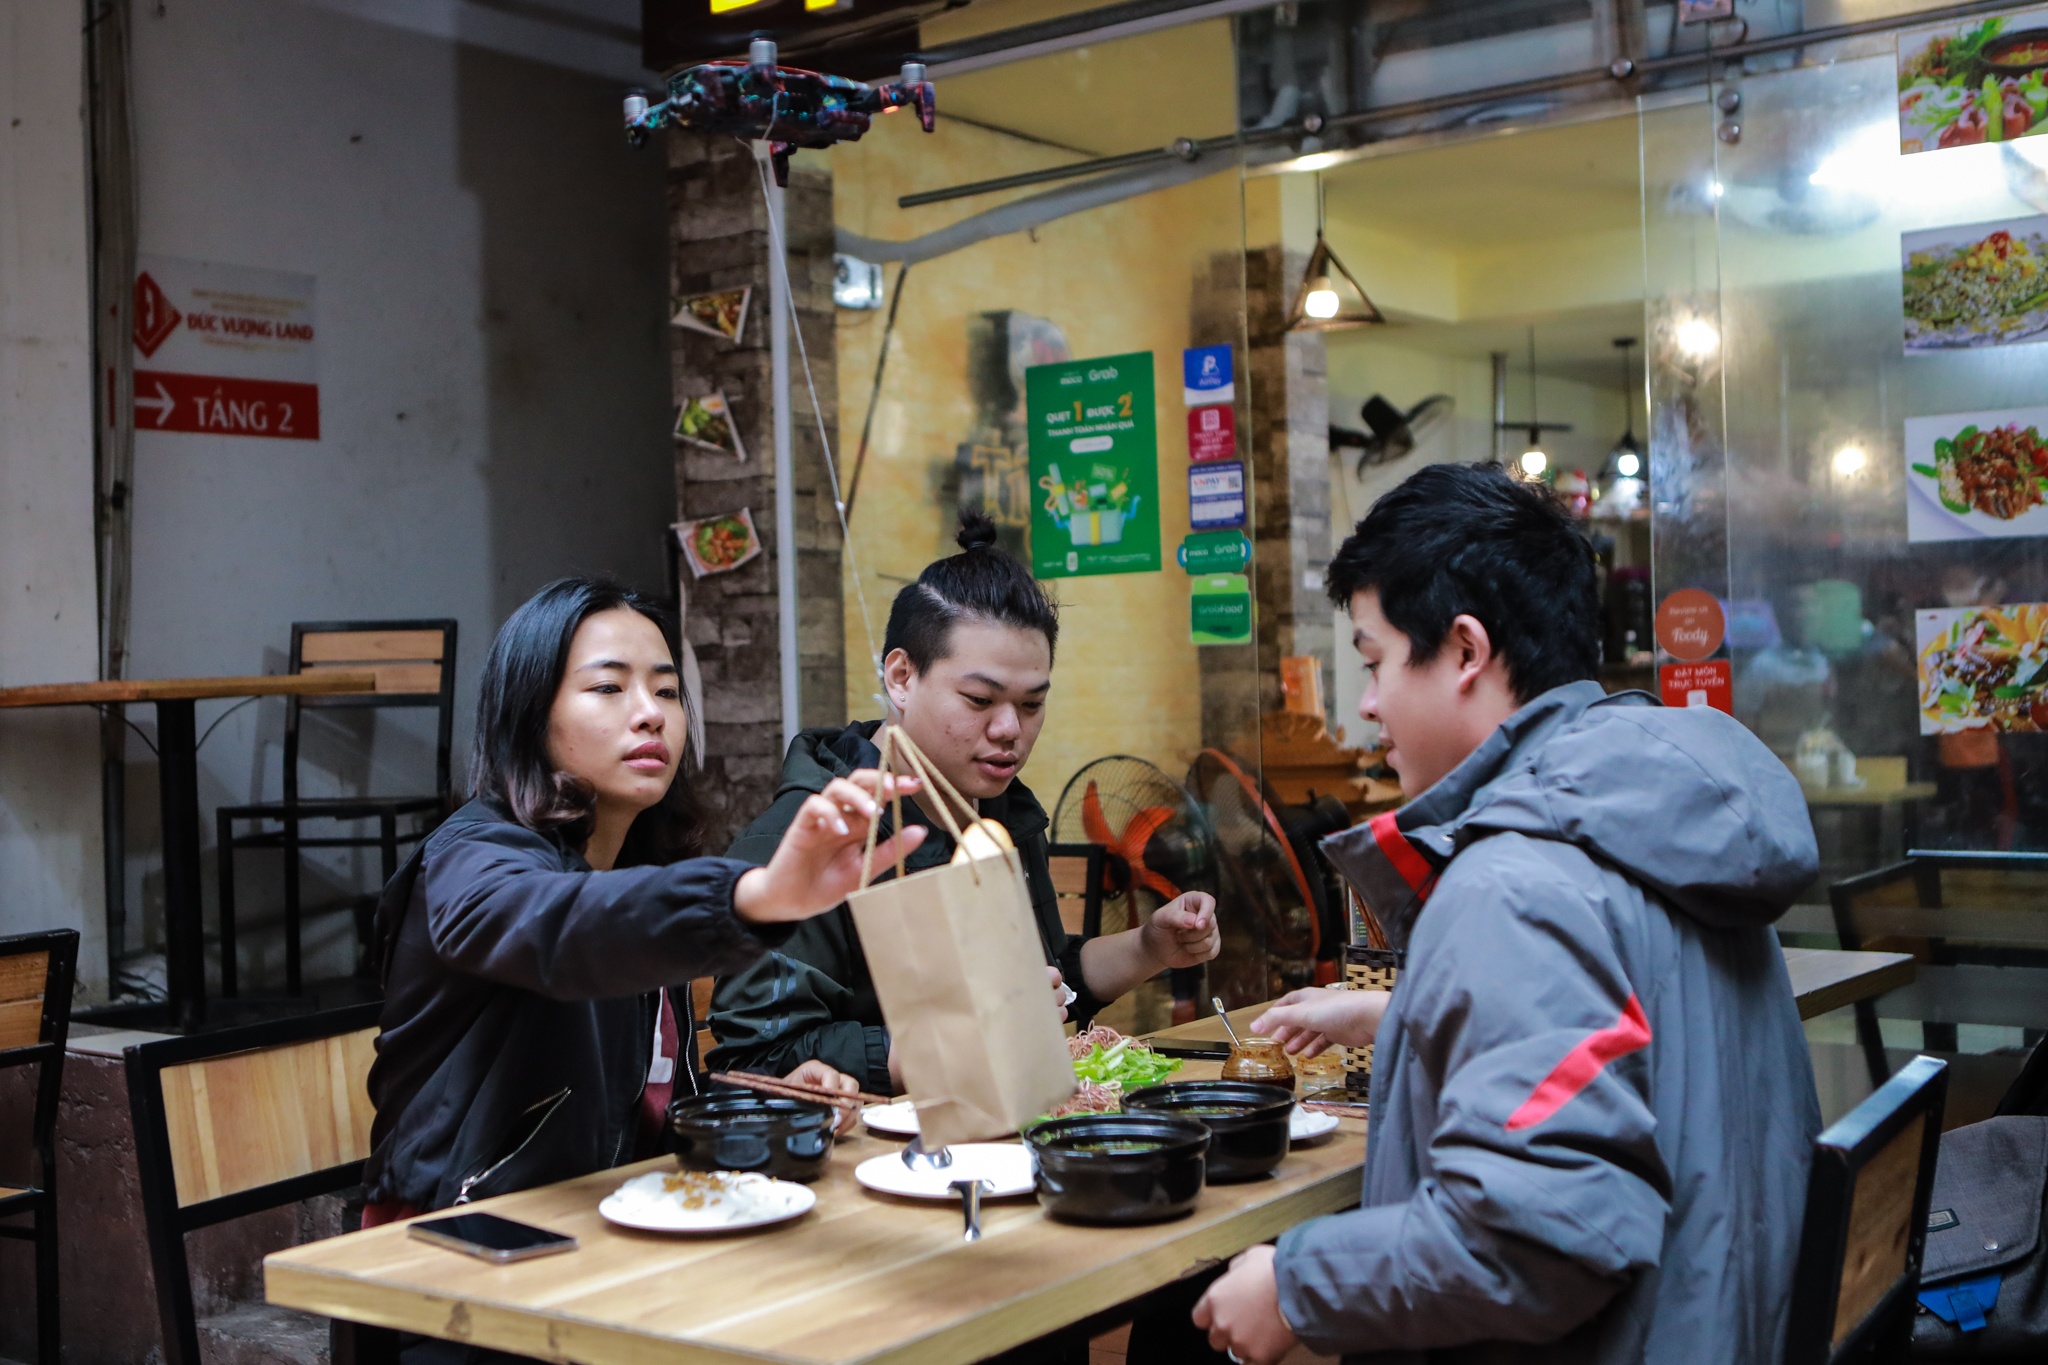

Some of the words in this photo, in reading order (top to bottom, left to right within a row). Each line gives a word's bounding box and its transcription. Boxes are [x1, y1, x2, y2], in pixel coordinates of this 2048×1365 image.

[276, 322, 314, 341] LAND
[1088, 366, 1118, 382] Grab
[278, 402, 294, 432] 2
[1073, 400, 1082, 422] 1
[1117, 393, 1133, 417] 2
[1214, 542, 1239, 554] Grab
[1672, 627, 1708, 646] Foody
